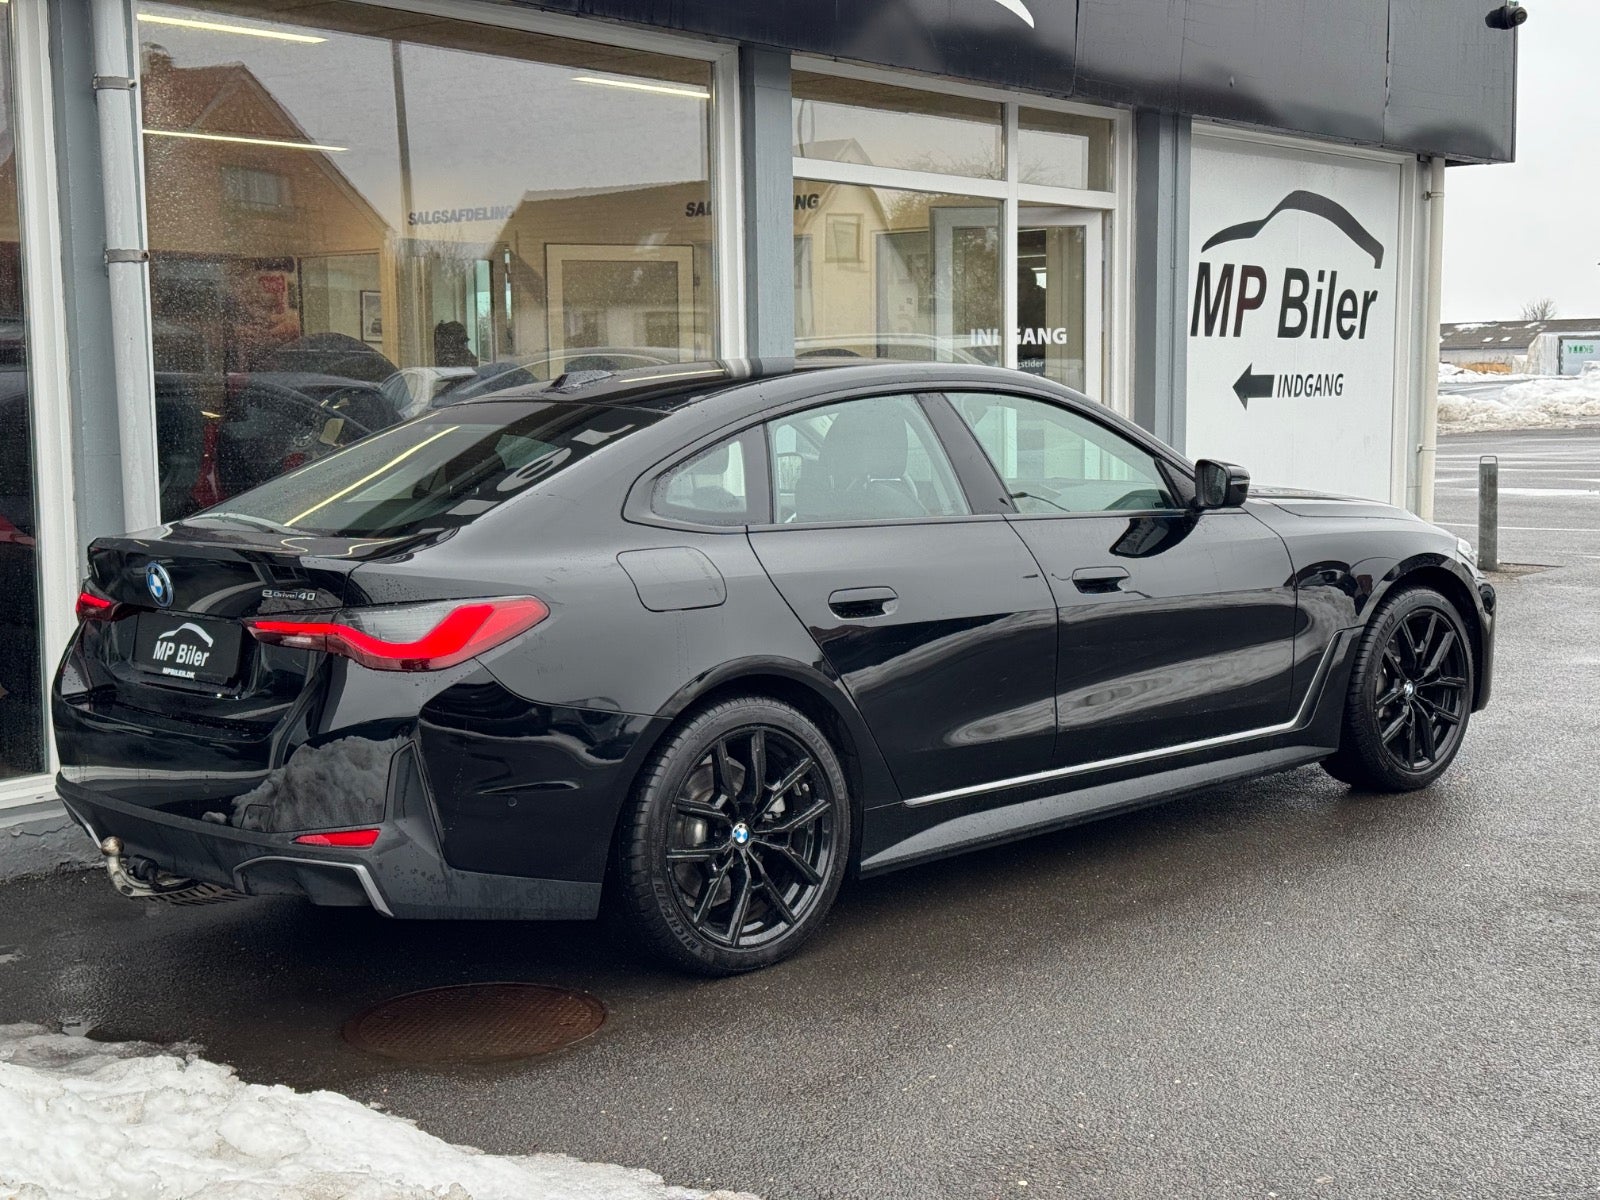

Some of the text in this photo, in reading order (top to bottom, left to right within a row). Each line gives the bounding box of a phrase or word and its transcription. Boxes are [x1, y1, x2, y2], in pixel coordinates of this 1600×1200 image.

[408, 205, 514, 226] SALGSAFDELING
[1190, 262, 1378, 340] MP Biler
[1277, 373, 1344, 398] INDGANG
[153, 640, 210, 667] MP Biler
